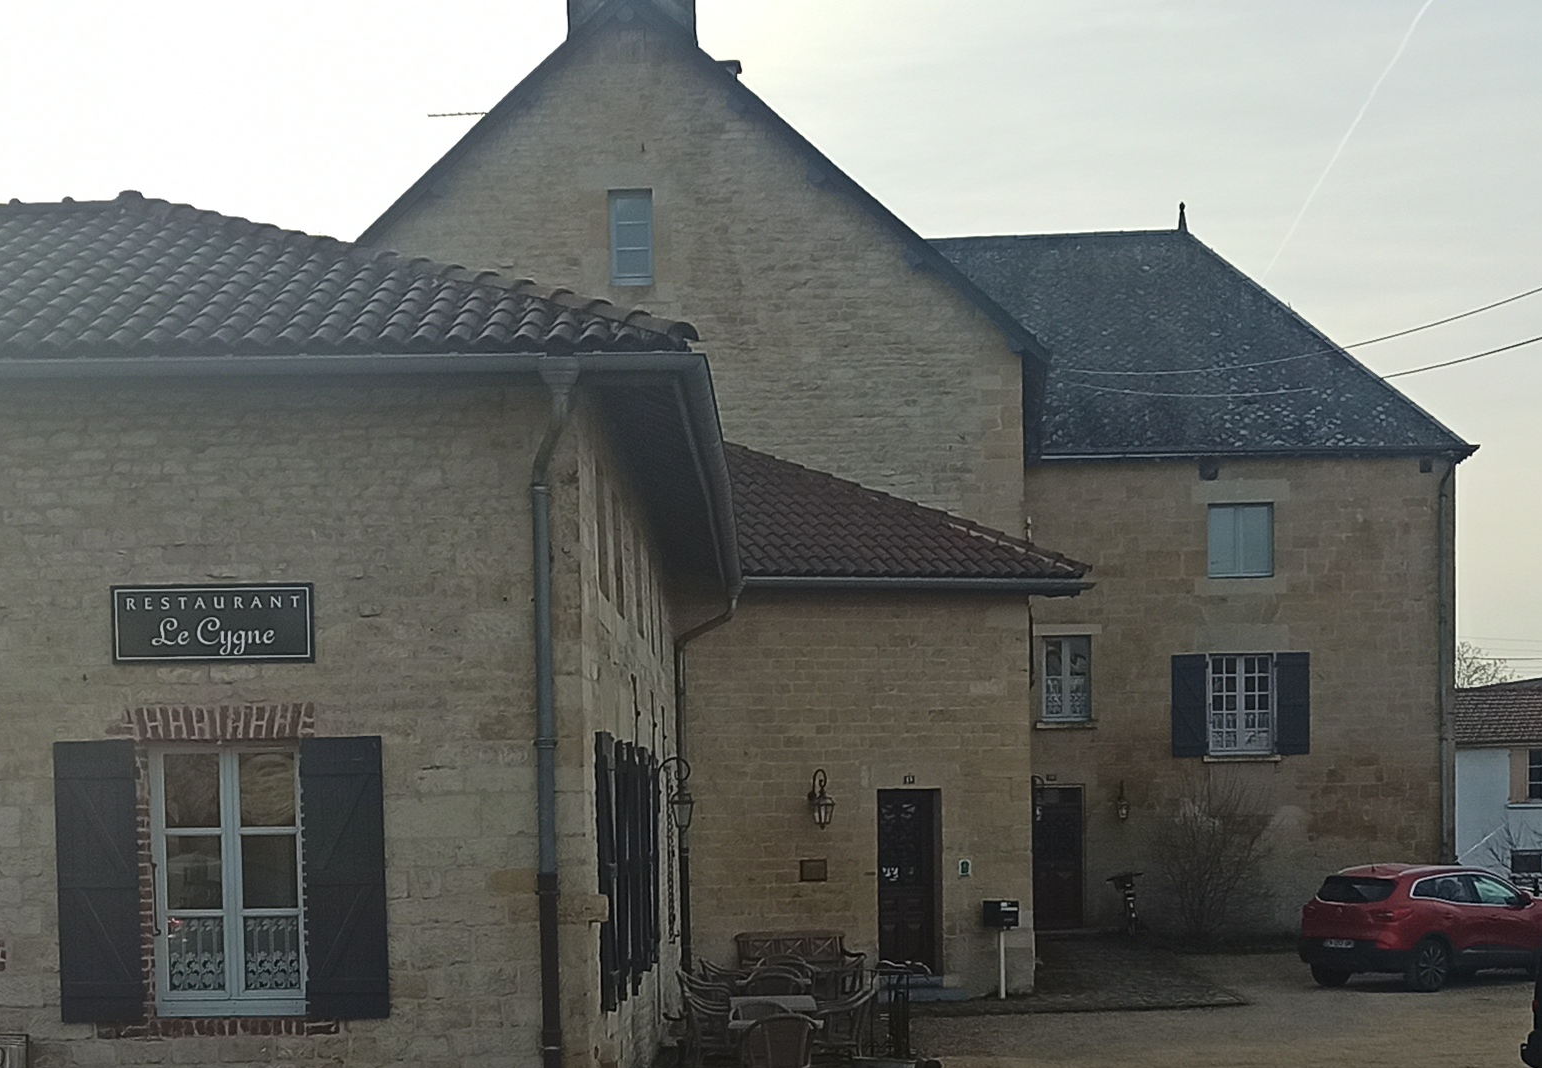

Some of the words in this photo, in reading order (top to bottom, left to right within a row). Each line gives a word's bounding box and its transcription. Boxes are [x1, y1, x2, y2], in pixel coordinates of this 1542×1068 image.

[126, 595, 301, 610] RESTAURANT
[151, 617, 190, 646] Le
[196, 616, 276, 655] Cygne
